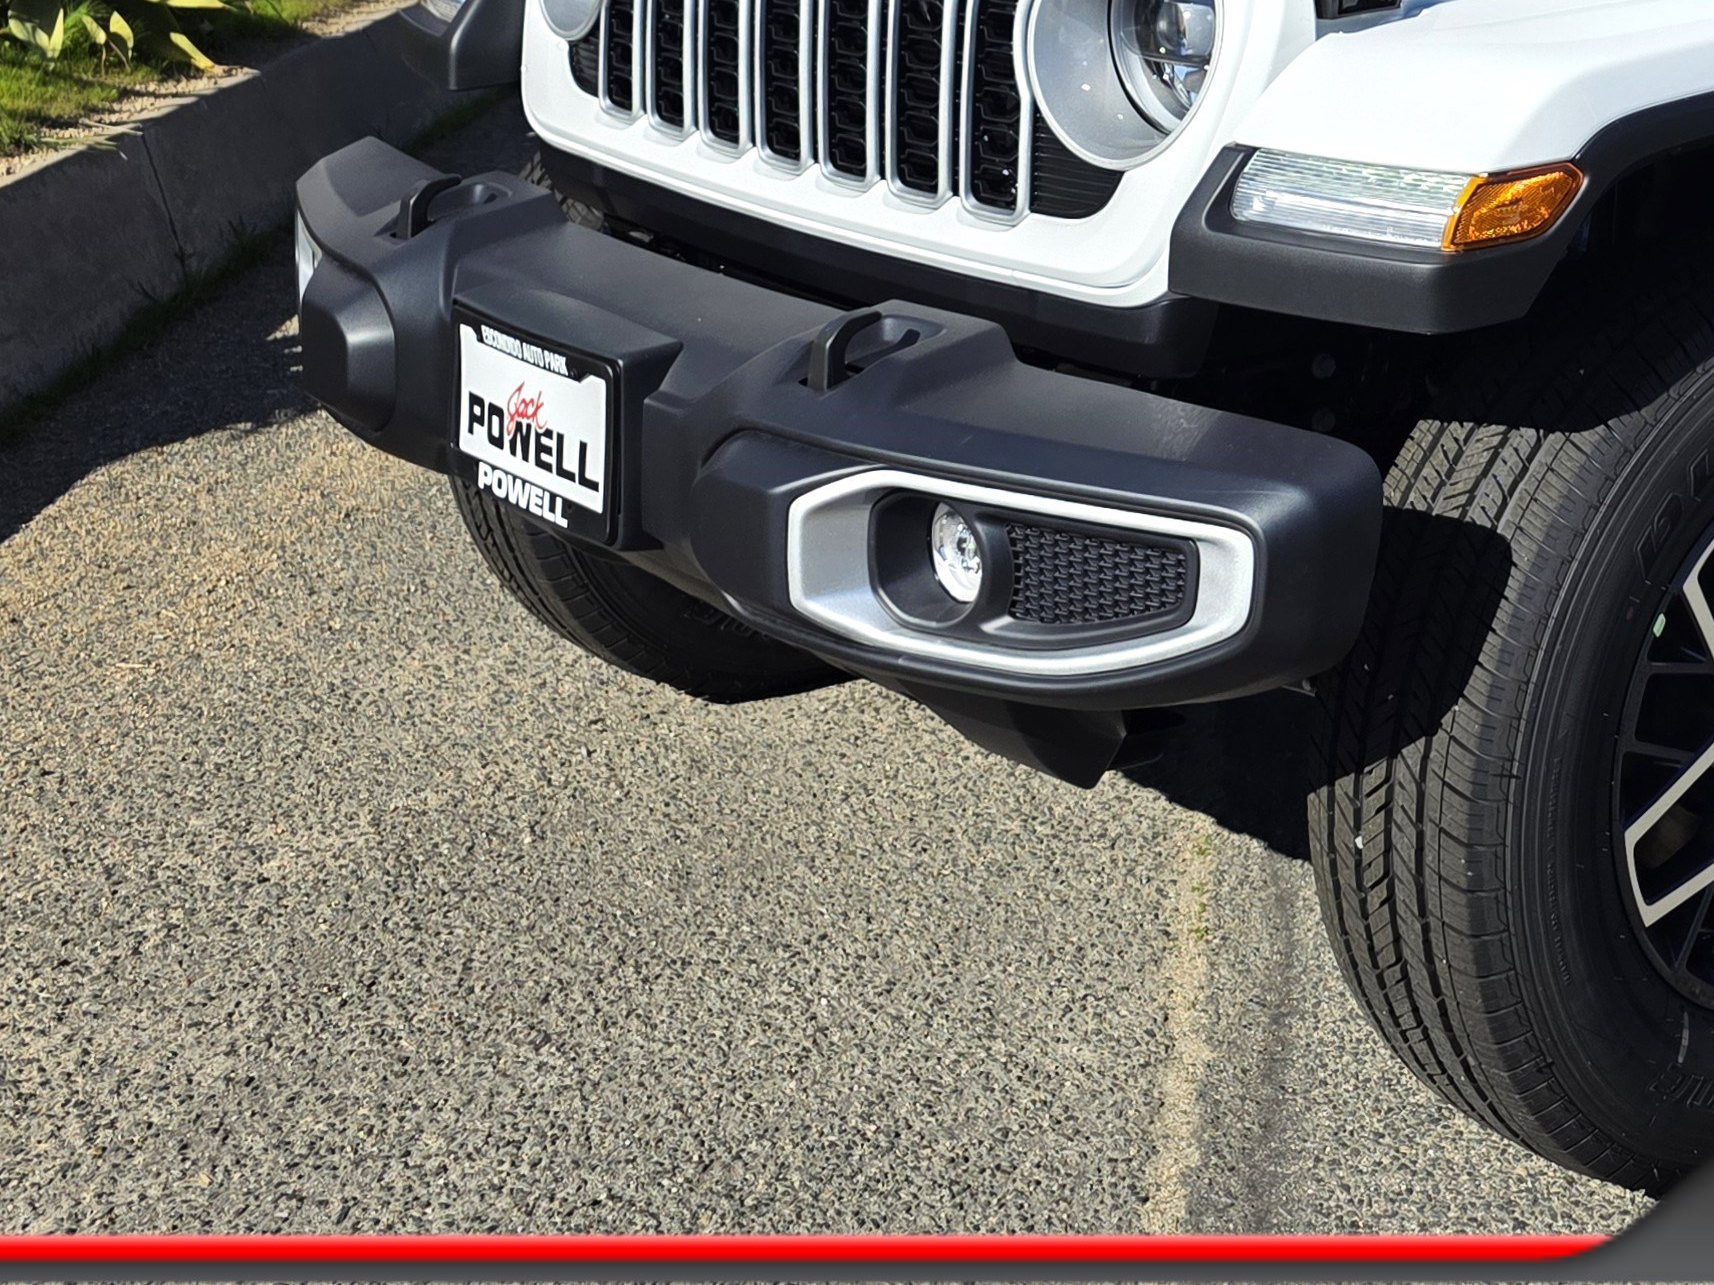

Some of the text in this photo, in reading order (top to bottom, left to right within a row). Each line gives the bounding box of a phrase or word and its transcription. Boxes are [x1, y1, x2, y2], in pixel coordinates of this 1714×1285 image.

[522, 342, 545, 367] AUTO
[543, 349, 568, 376] PARK
[507, 381, 548, 437] Jack
[467, 390, 600, 494] POWELL
[477, 461, 569, 529] POWELL
